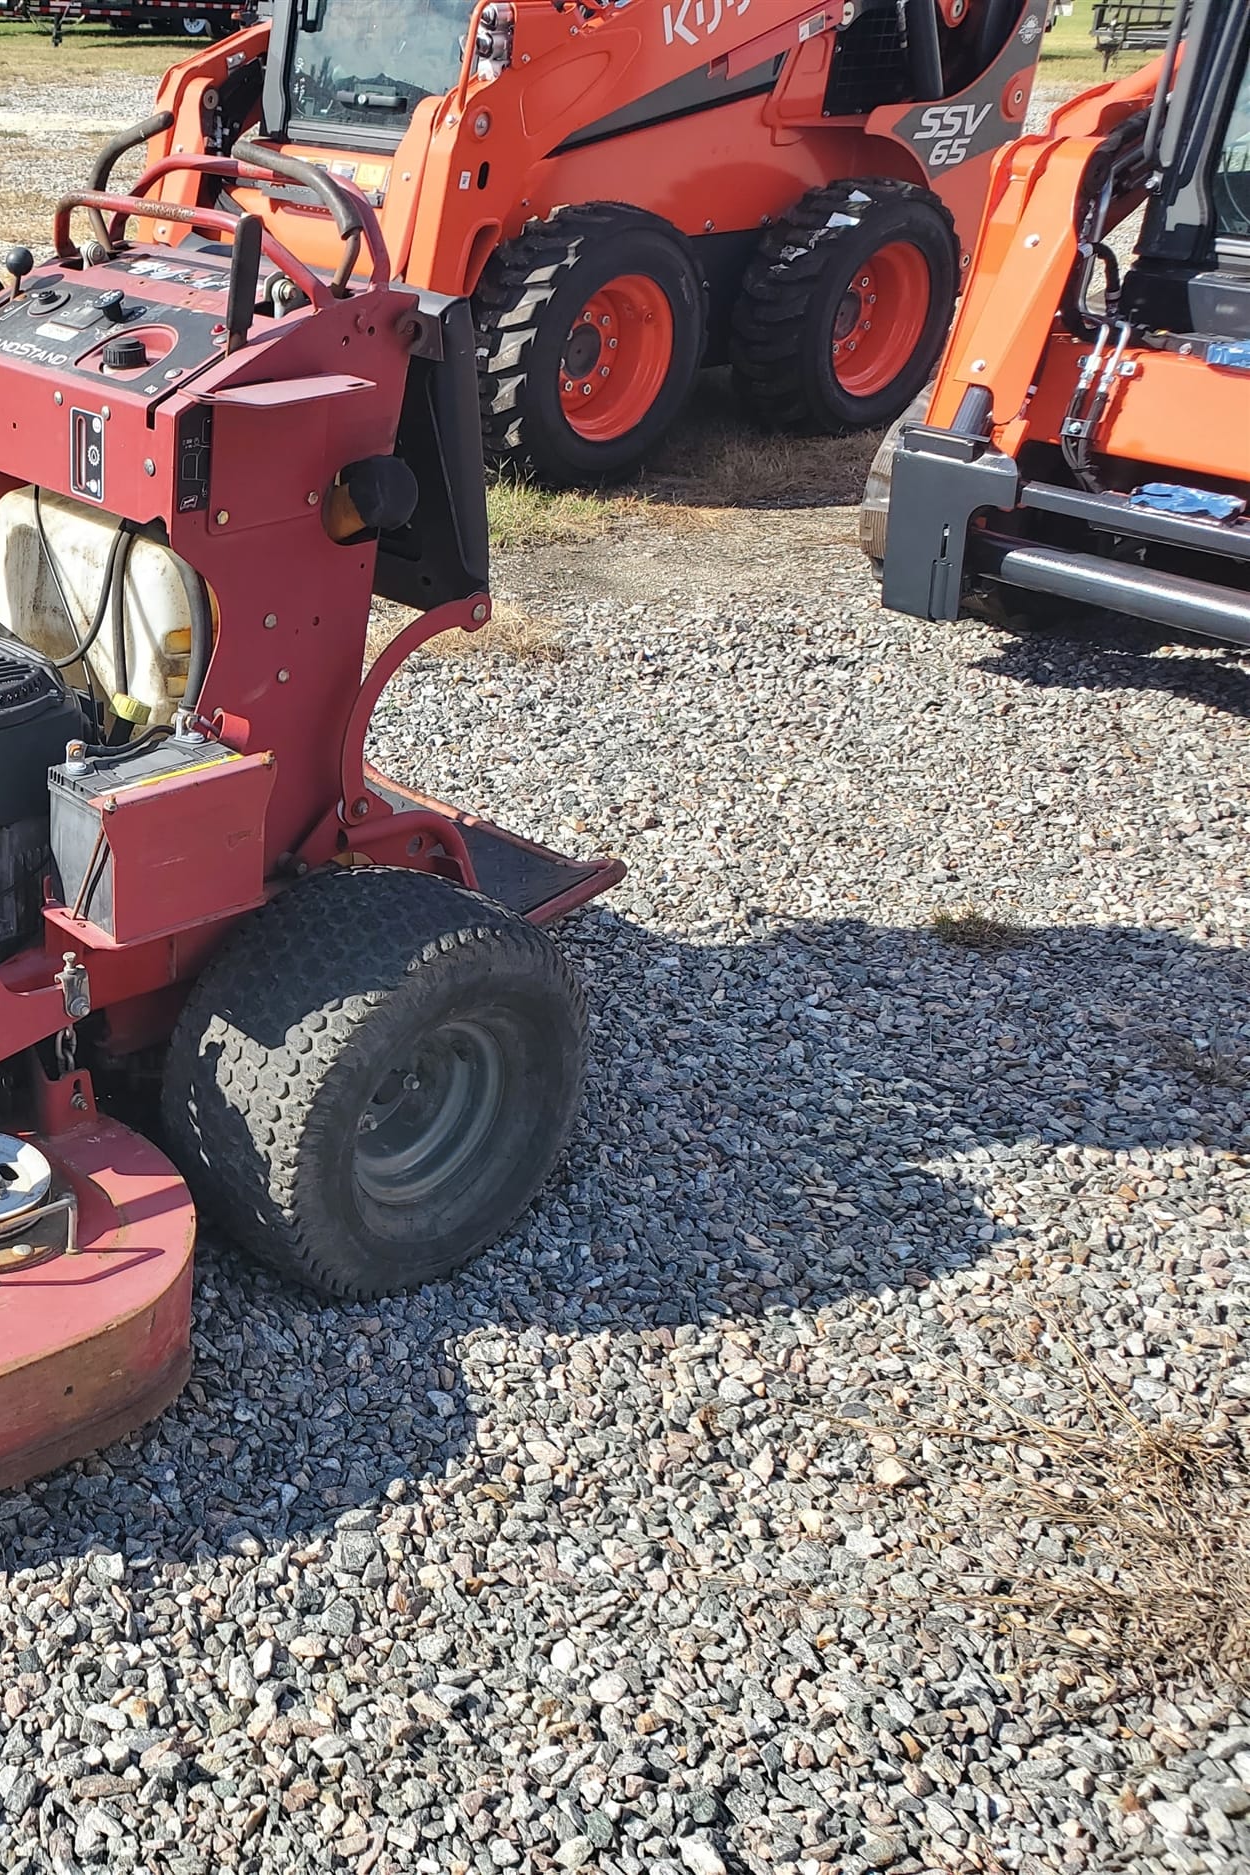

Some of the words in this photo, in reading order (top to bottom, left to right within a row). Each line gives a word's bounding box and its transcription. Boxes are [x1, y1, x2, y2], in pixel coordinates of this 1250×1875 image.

[663, 0, 751, 45] Ku
[913, 103, 993, 140] SSV
[928, 138, 971, 166] 65
